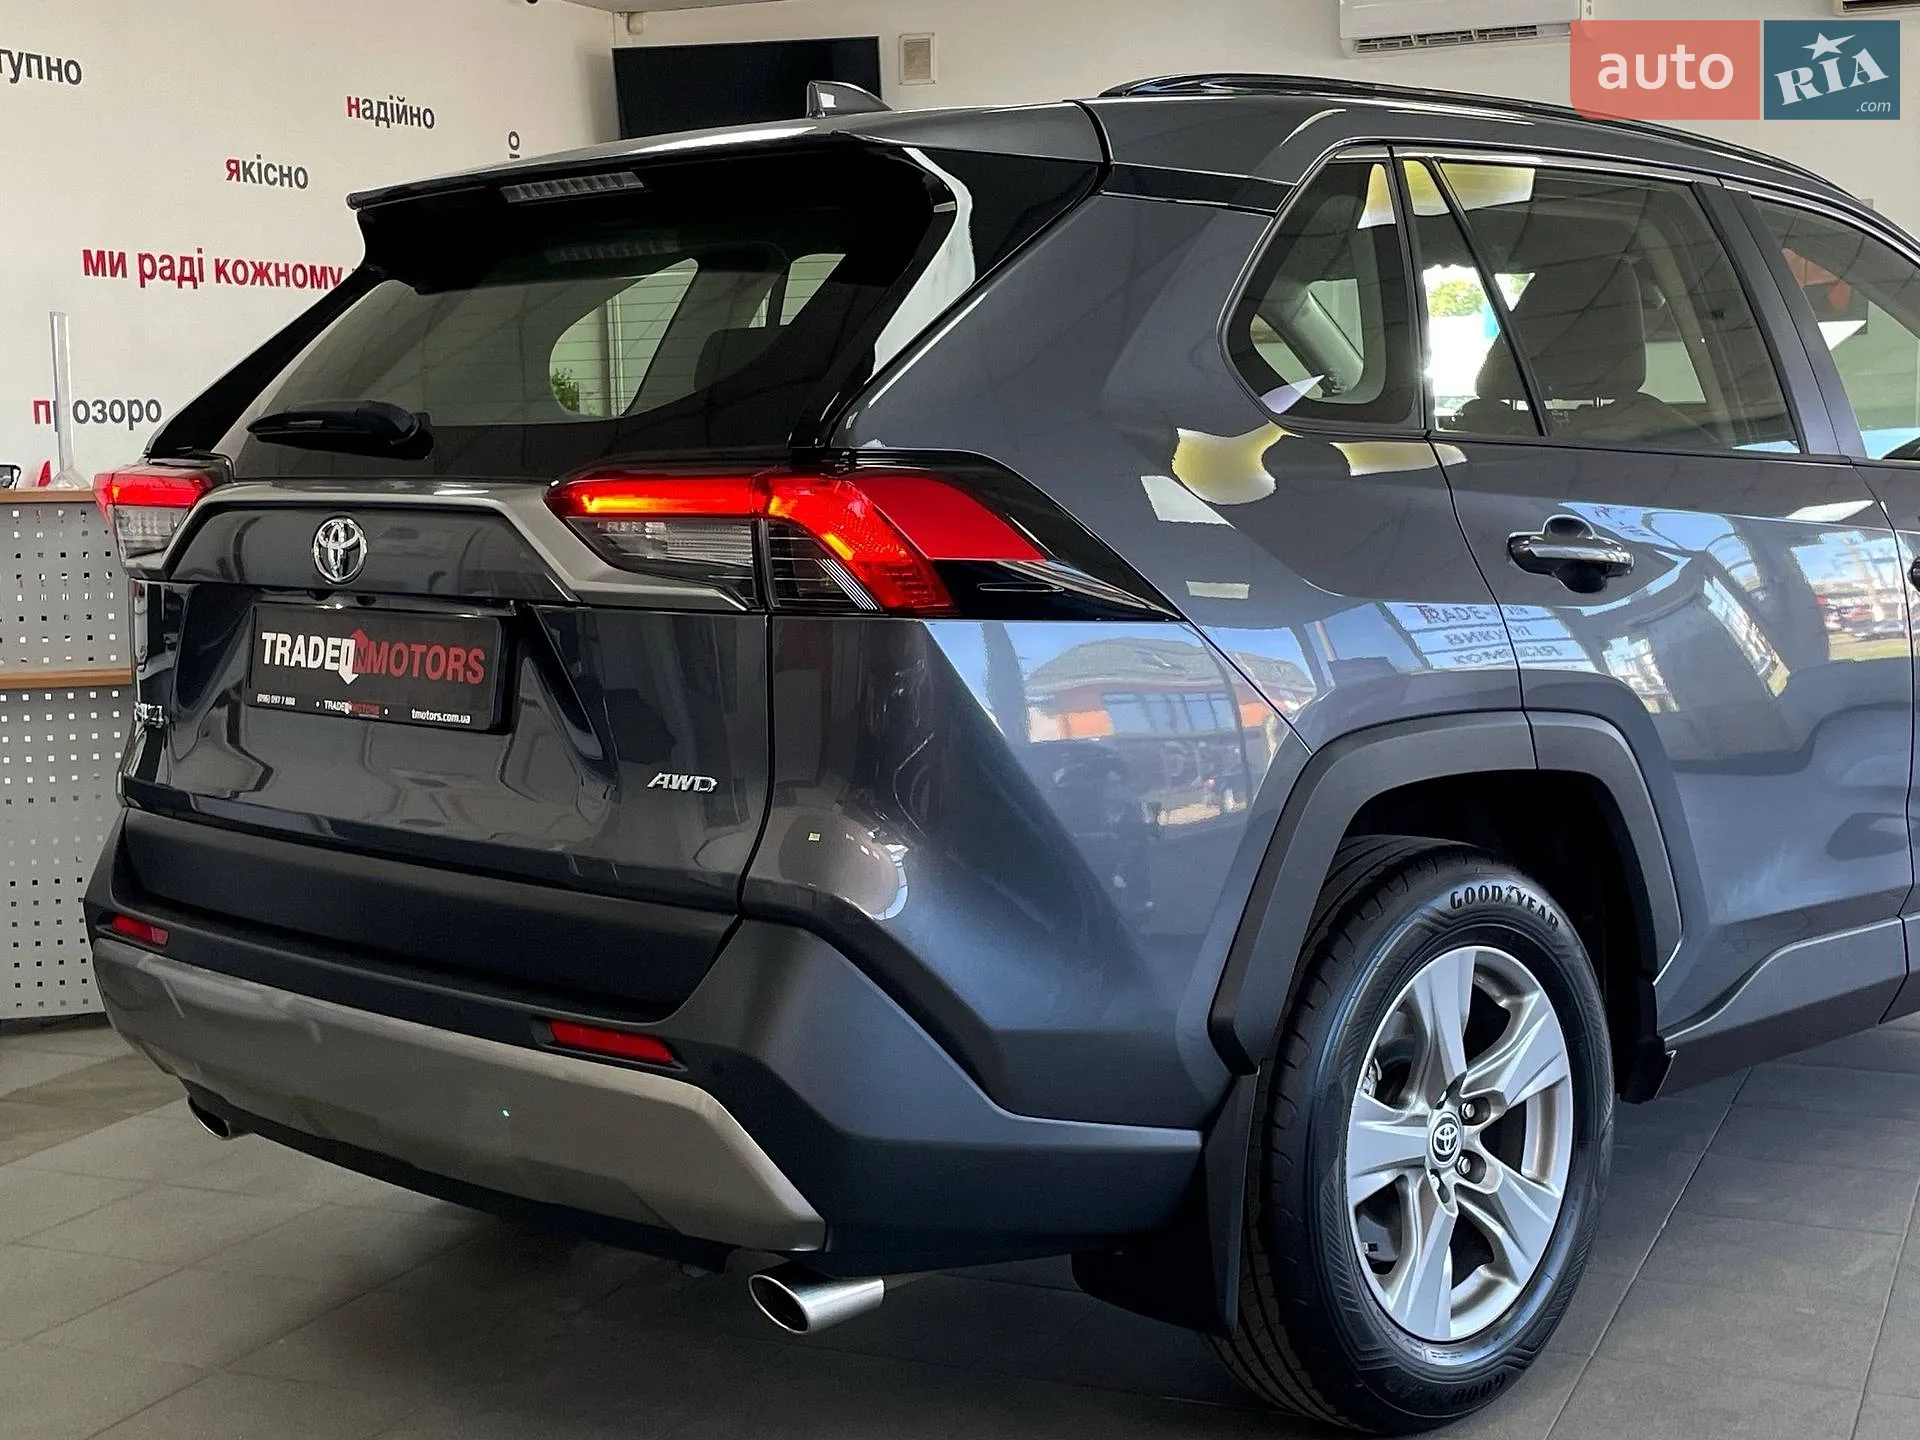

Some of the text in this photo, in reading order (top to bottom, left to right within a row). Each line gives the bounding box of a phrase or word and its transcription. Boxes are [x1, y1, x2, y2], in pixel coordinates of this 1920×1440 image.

[346, 95, 435, 131] надійно
[225, 154, 309, 190] якісно
[82, 247, 345, 291] ми раді кожному
[33, 398, 162, 432] позоро
[411, 708, 471, 724] tmotors.com.ua
[647, 772, 718, 793] AWD
